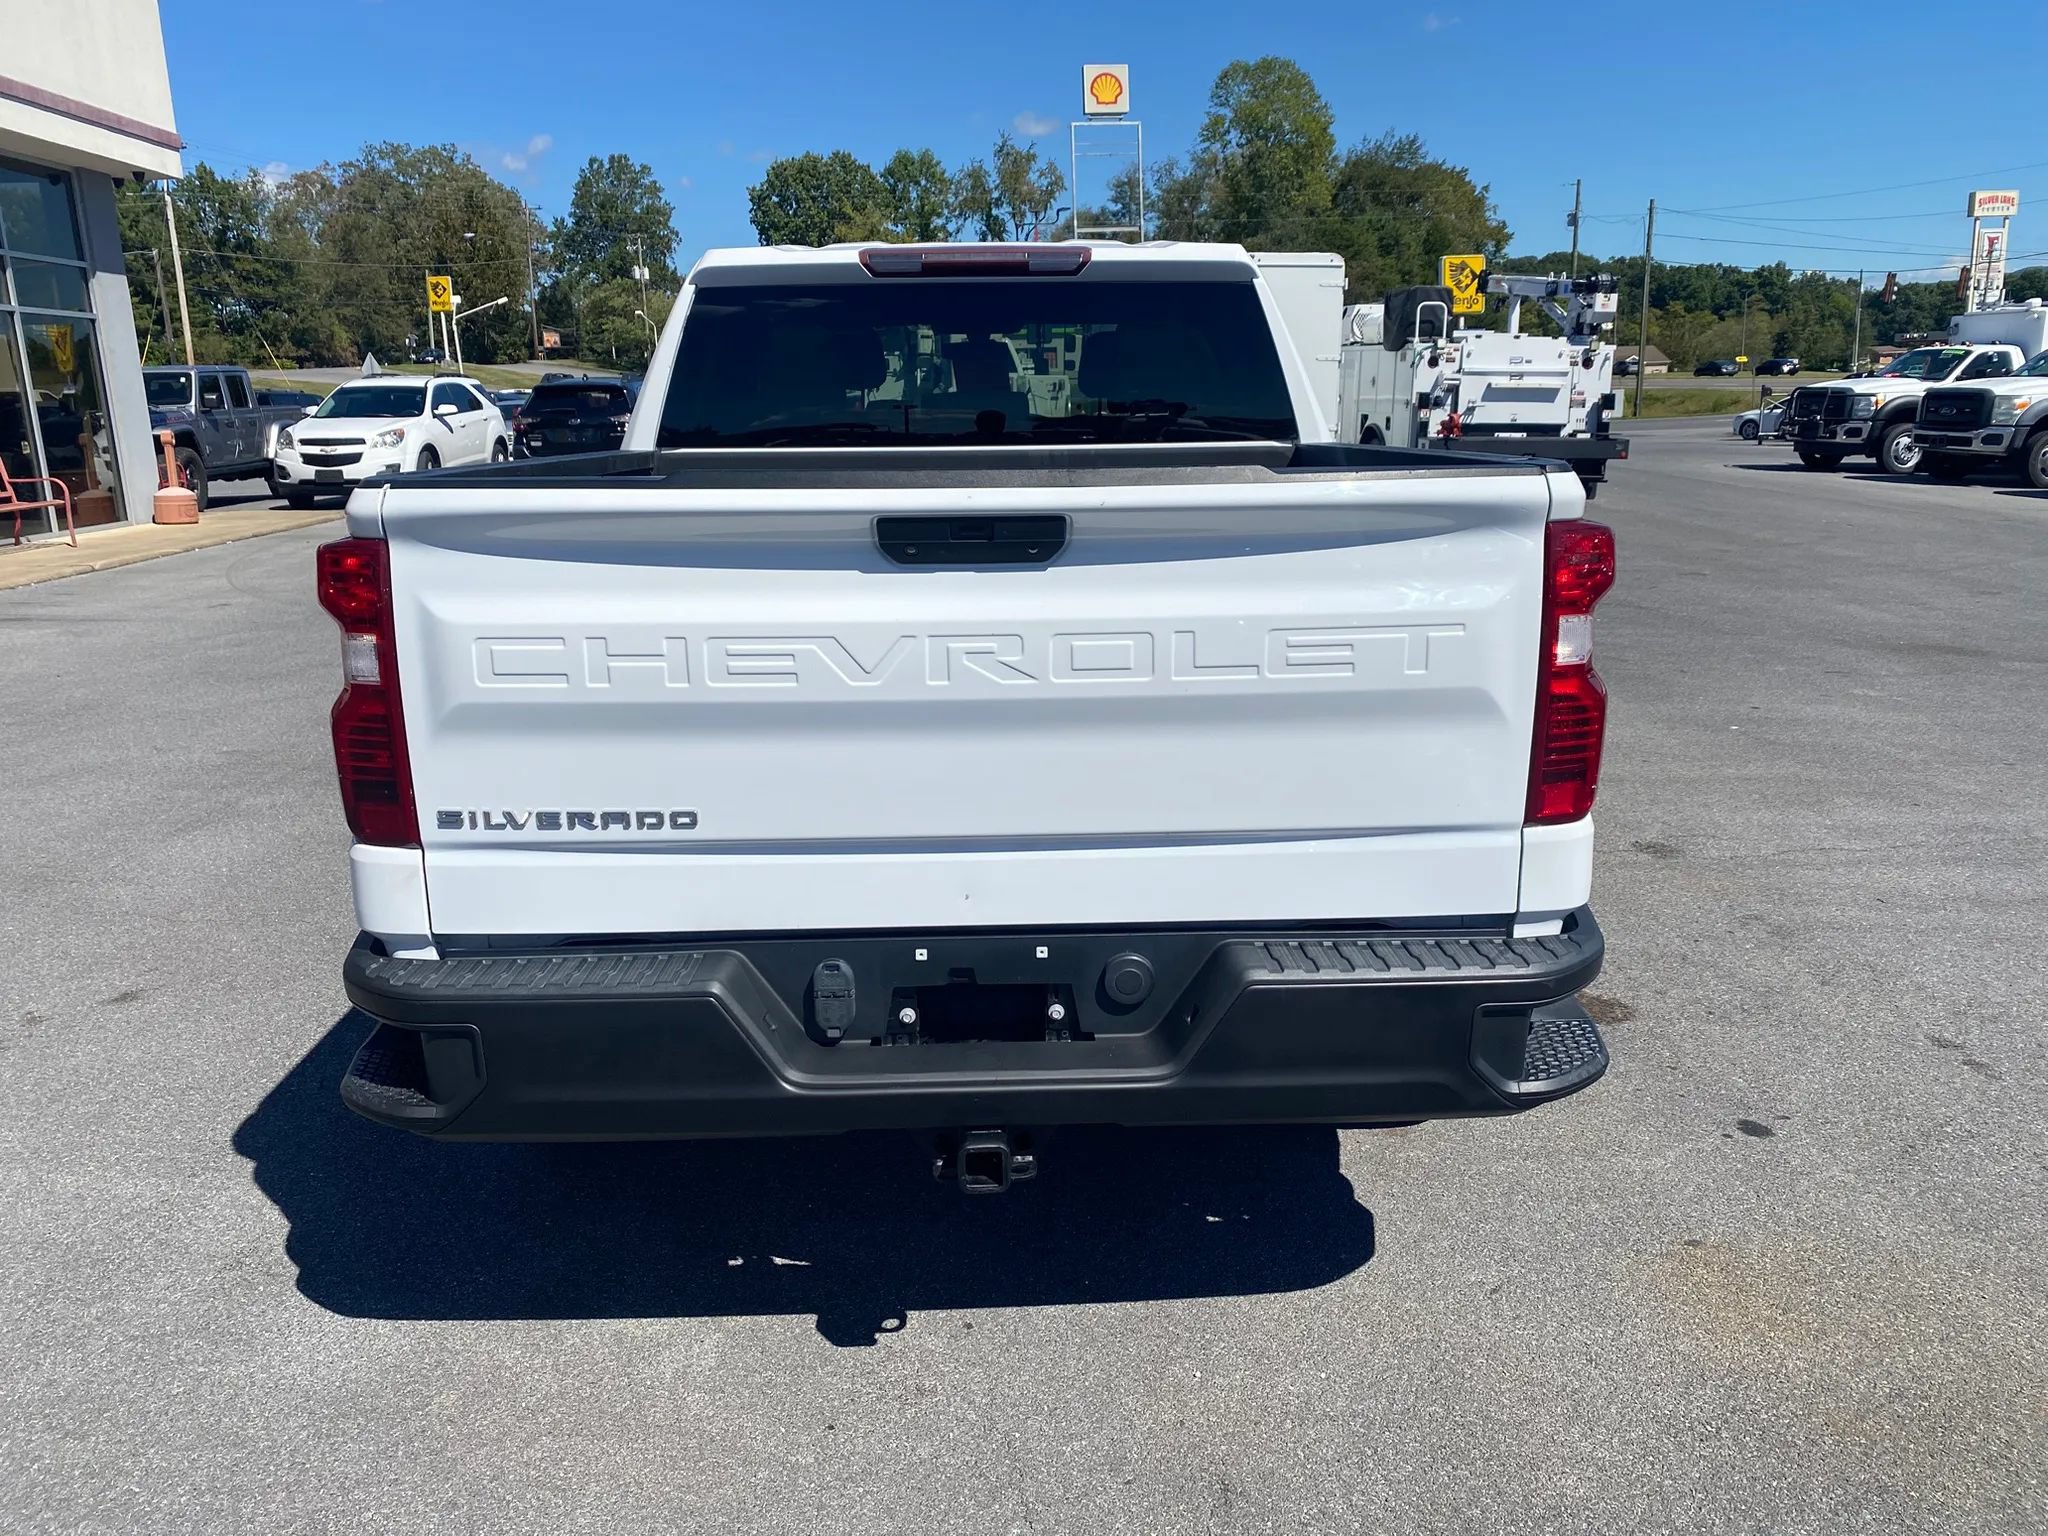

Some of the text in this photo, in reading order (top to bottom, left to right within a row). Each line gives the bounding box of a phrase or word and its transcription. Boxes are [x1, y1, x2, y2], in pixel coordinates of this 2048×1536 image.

[1978, 195, 2016, 207] SILVER LAKE
[472, 622, 1466, 689] CHEVROLET
[436, 810, 699, 831] SILVERADO
